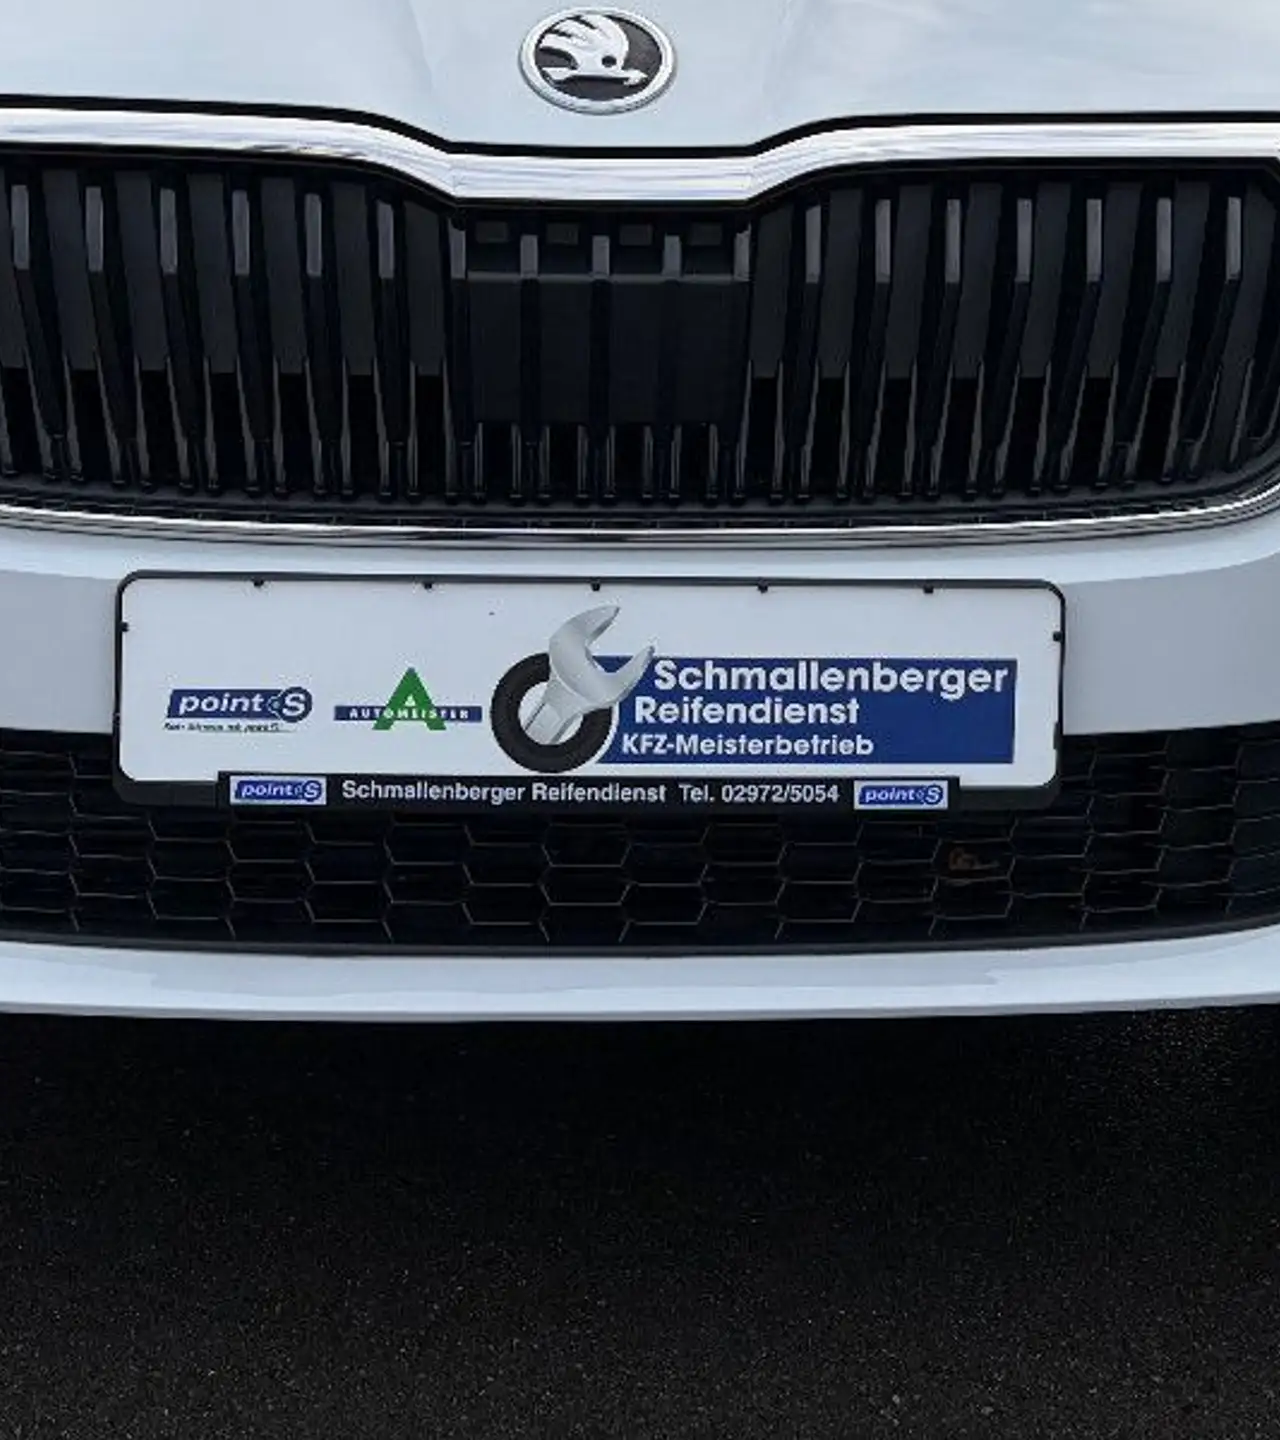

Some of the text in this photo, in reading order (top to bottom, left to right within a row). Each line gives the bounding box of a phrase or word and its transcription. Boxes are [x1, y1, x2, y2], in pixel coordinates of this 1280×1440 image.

[653, 659, 1009, 701] Schmallenberger
[178, 692, 265, 716] point
[348, 708, 470, 720] AUTOMEISTER
[634, 695, 861, 725] Reifendienst
[621, 732, 875, 756] KFZ-Meisterbetrieb
[239, 782, 293, 799] point
[341, 780, 840, 805] Schmallenberger Reifendienst Tel. 02972/5054
[863, 786, 916, 804] point
